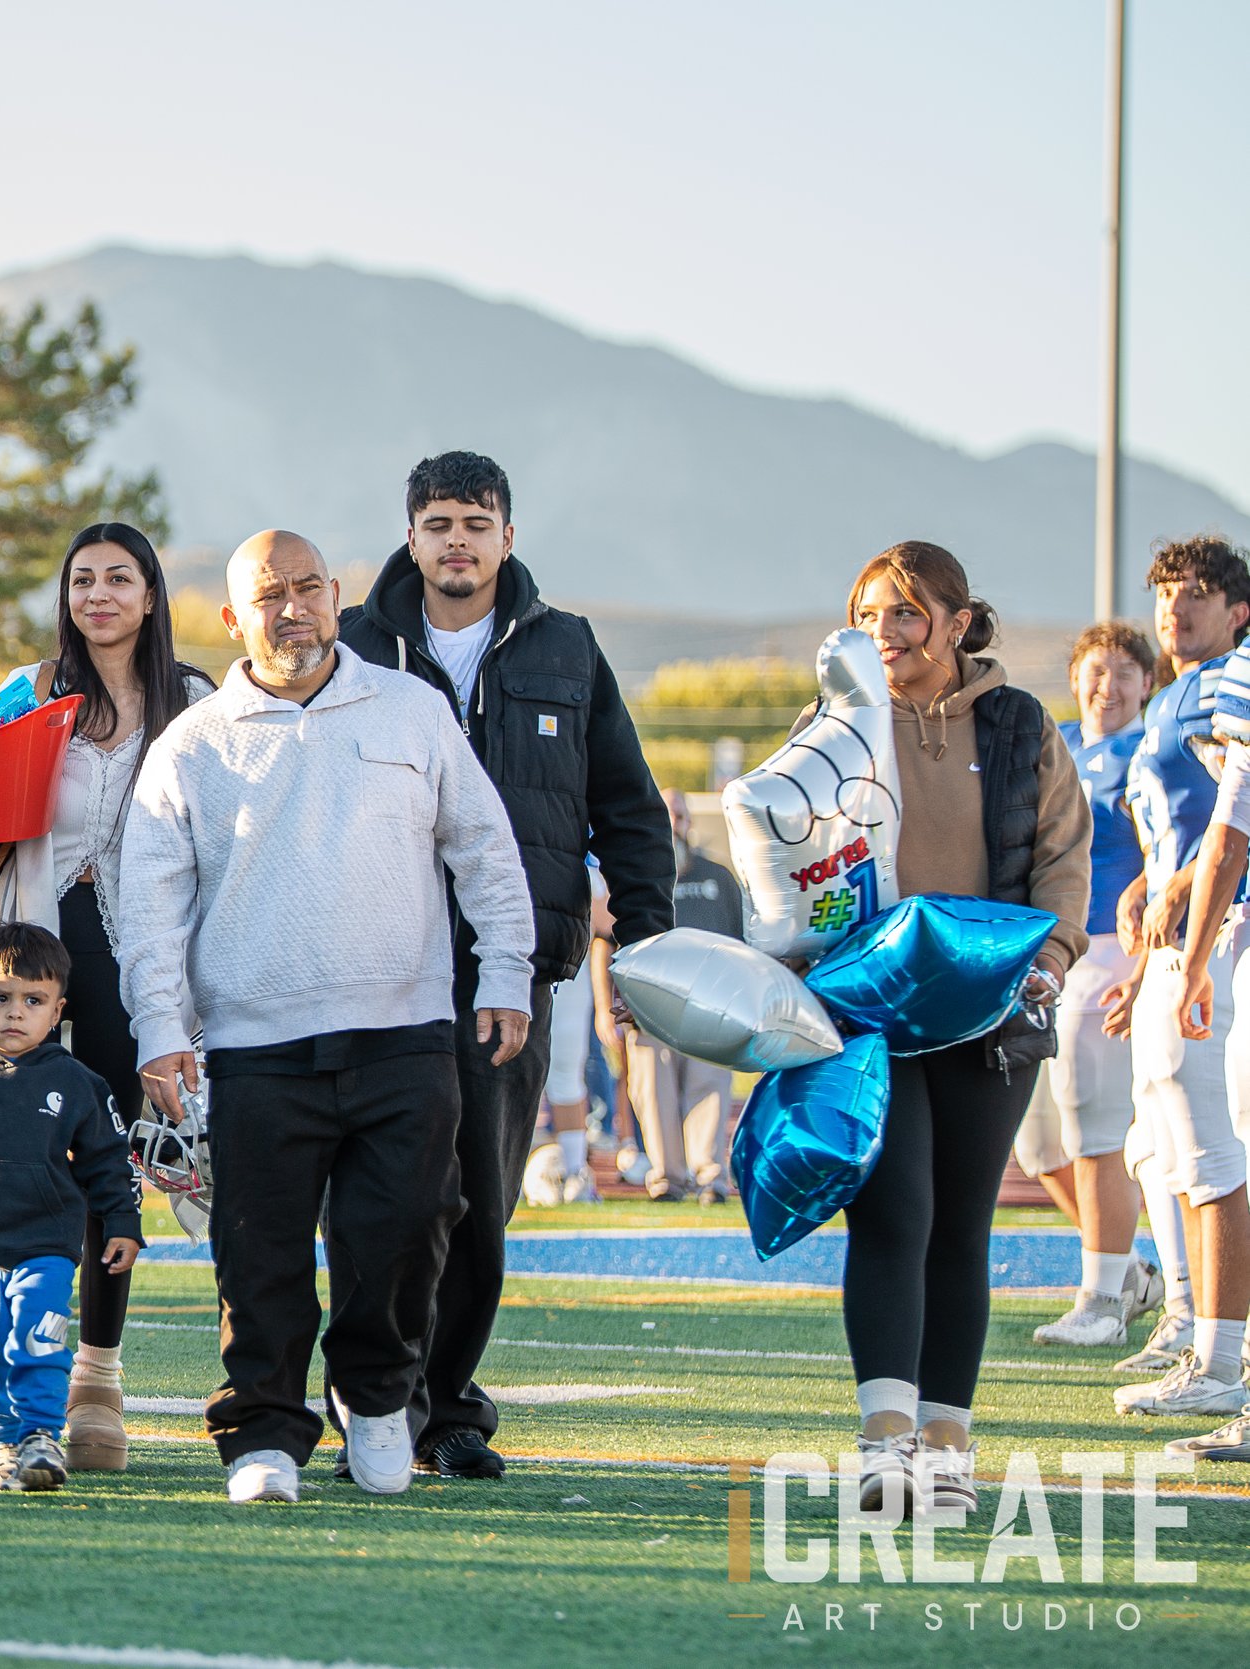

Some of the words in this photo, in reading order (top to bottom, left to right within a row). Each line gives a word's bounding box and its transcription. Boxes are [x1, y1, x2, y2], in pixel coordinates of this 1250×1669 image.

[789, 836, 870, 892] YOU'RE
[808, 856, 885, 938] #1
[34, 1310, 68, 1344] NIK
